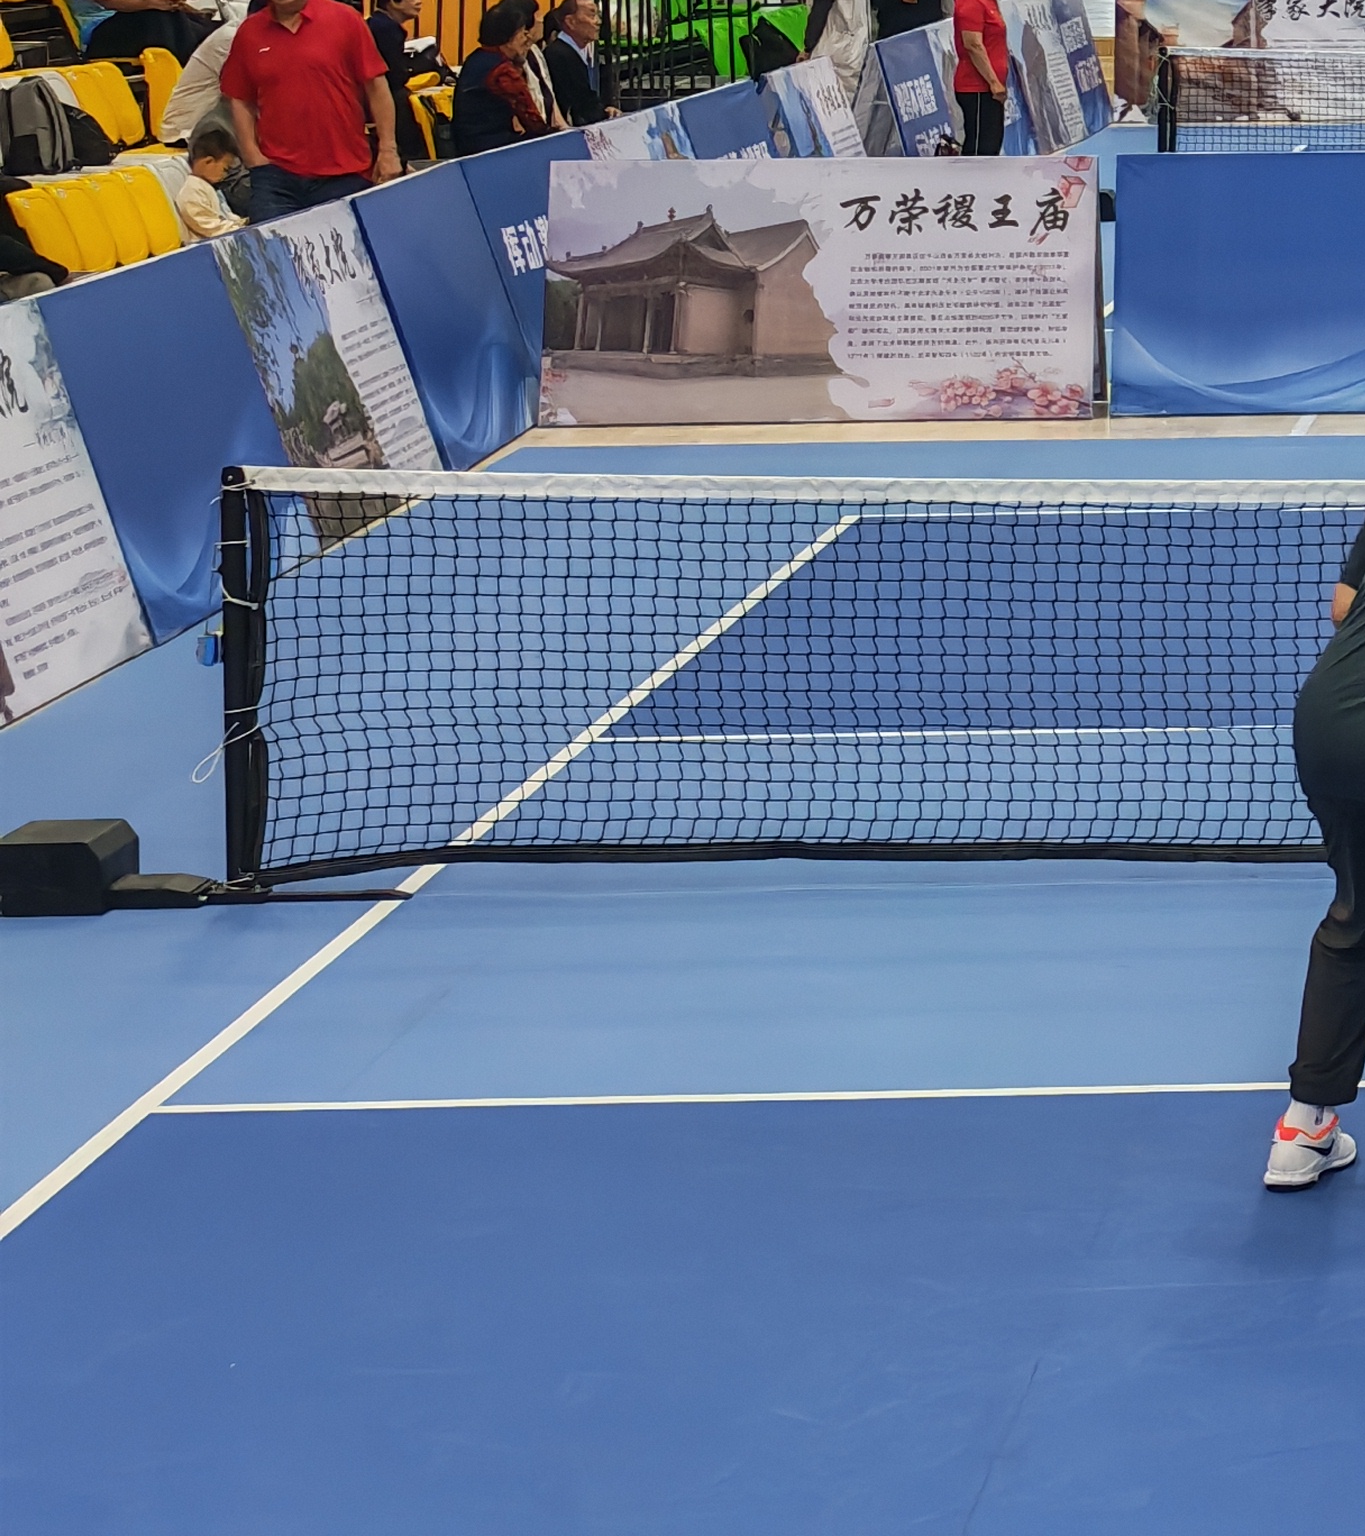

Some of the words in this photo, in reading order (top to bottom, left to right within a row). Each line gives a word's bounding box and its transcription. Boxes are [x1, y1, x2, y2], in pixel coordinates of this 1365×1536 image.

[839, 188, 1070, 237] 万荣稷王庙
